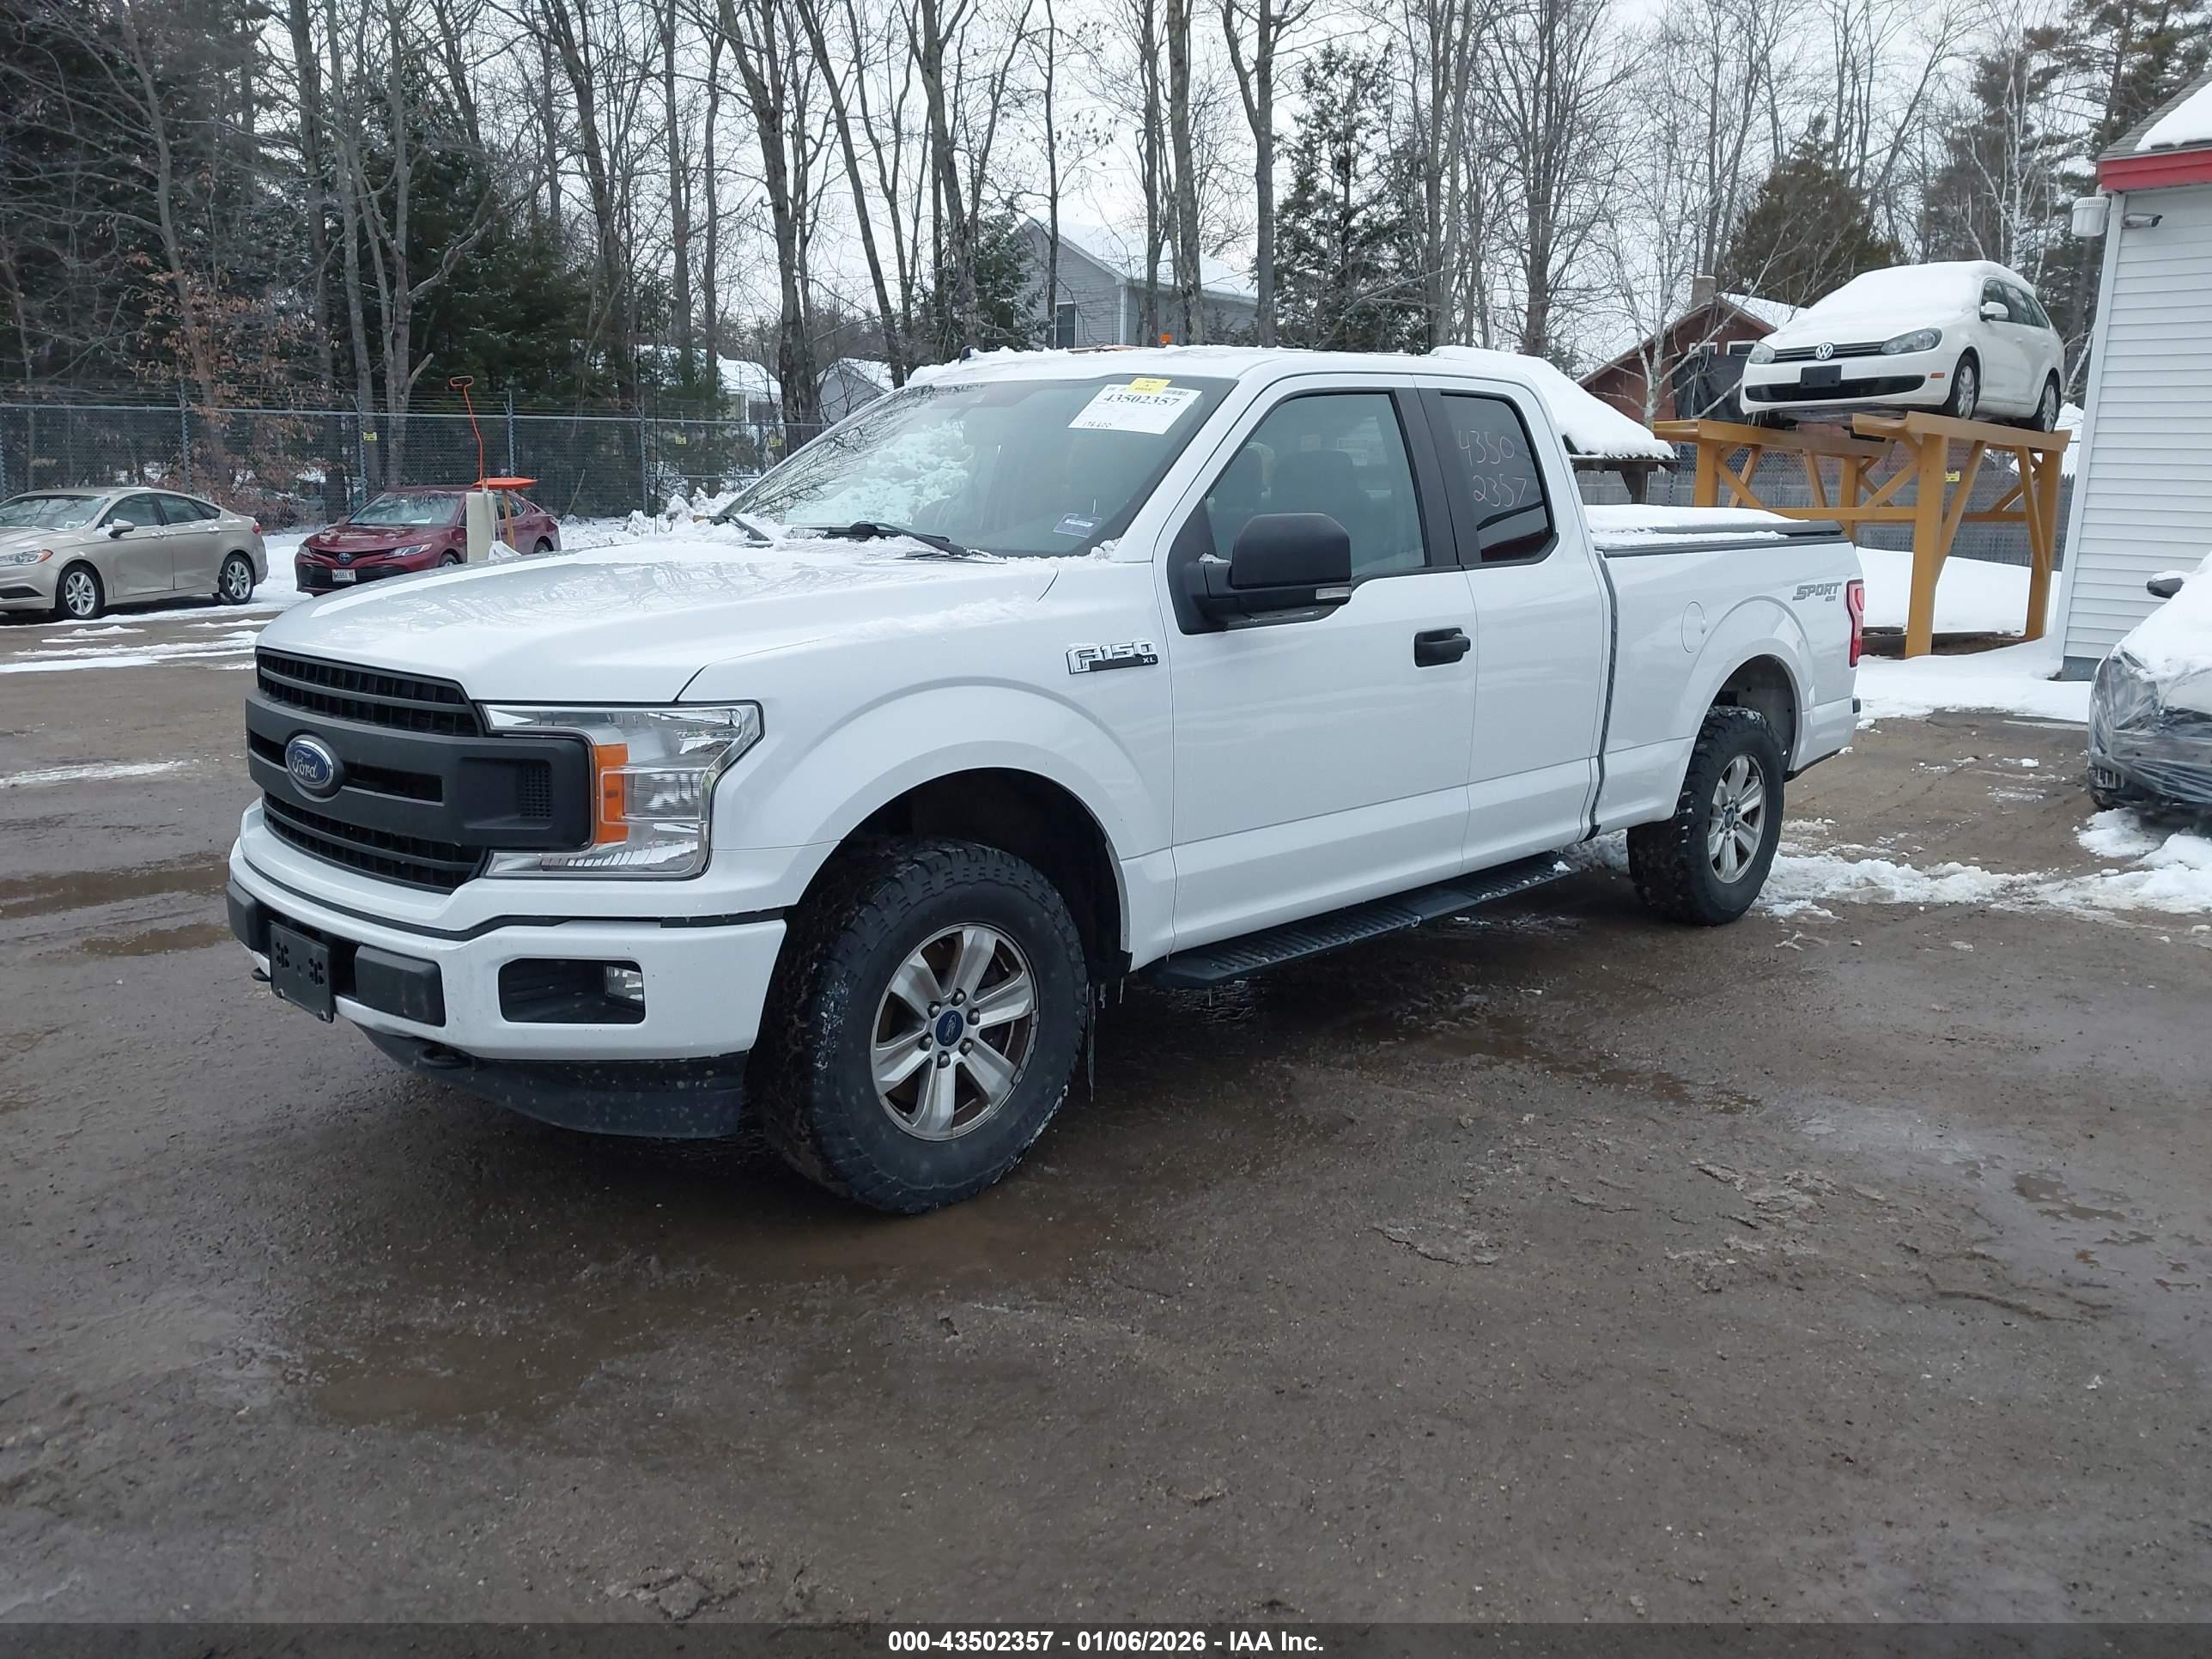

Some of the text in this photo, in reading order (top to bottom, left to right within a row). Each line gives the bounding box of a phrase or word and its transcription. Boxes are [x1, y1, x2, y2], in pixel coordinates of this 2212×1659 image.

[1103, 393, 1182, 407] 43502357
[1459, 430, 1515, 467] 4350
[1472, 473, 1528, 507] 2357
[1792, 582, 1843, 601] SPORT
[292, 750, 318, 779] Ford
